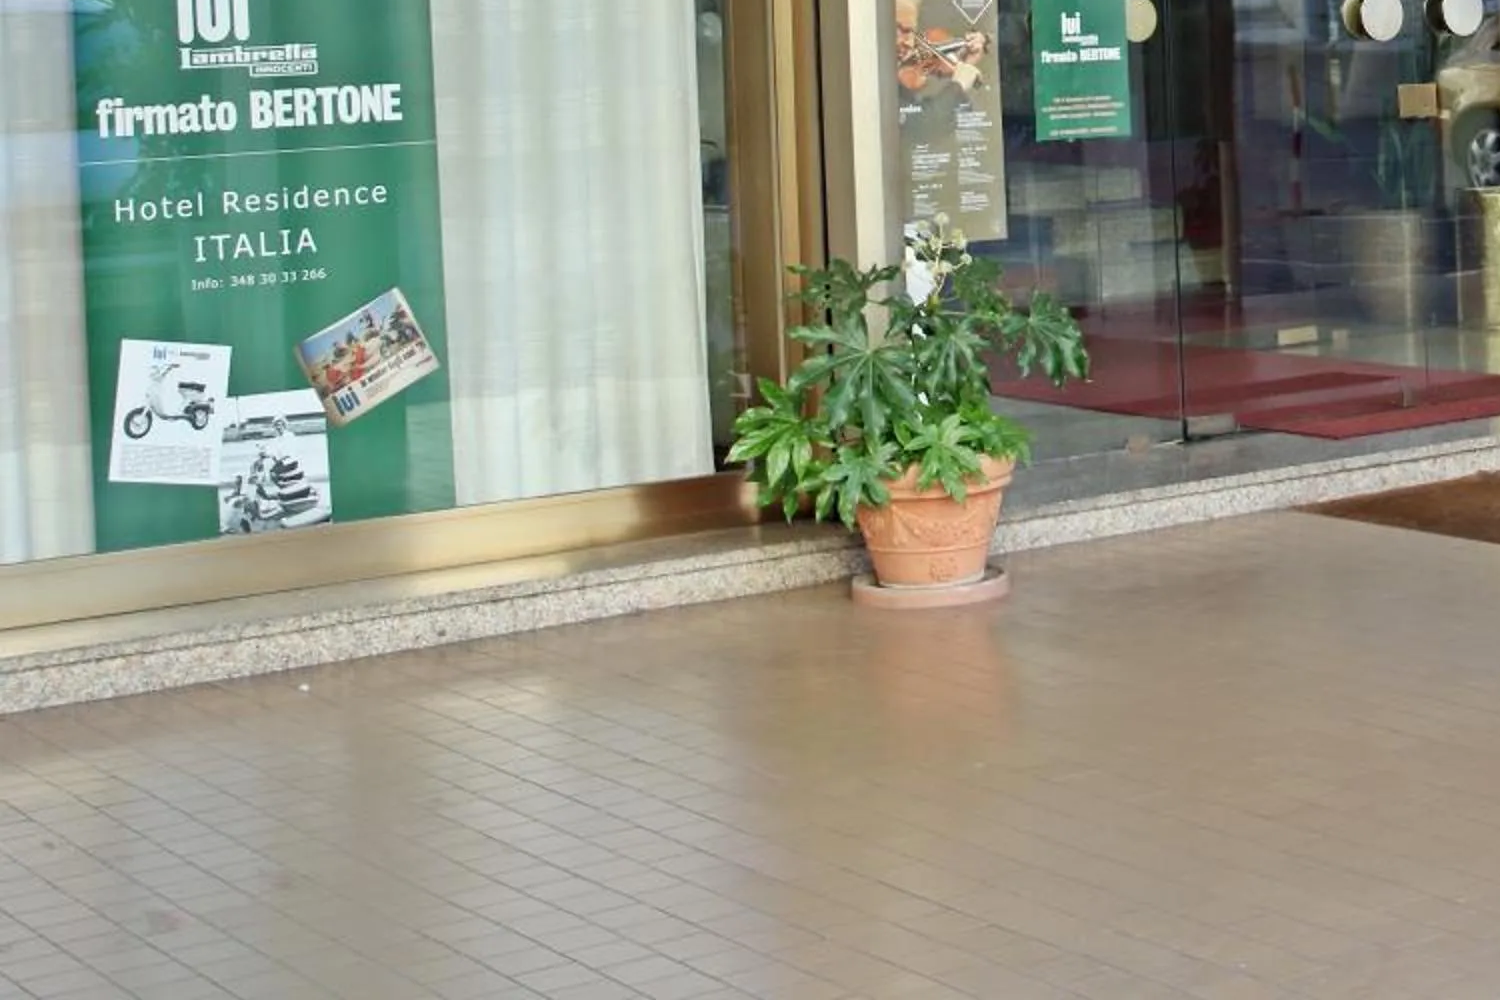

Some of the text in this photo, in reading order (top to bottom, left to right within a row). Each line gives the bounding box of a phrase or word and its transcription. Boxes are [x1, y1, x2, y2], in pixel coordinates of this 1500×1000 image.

[96, 83, 403, 138] firmato BERTONE
[113, 183, 389, 223] Hotel Residence
[193, 227, 318, 263] ITALIA
[191, 276, 225, 291] Info:
